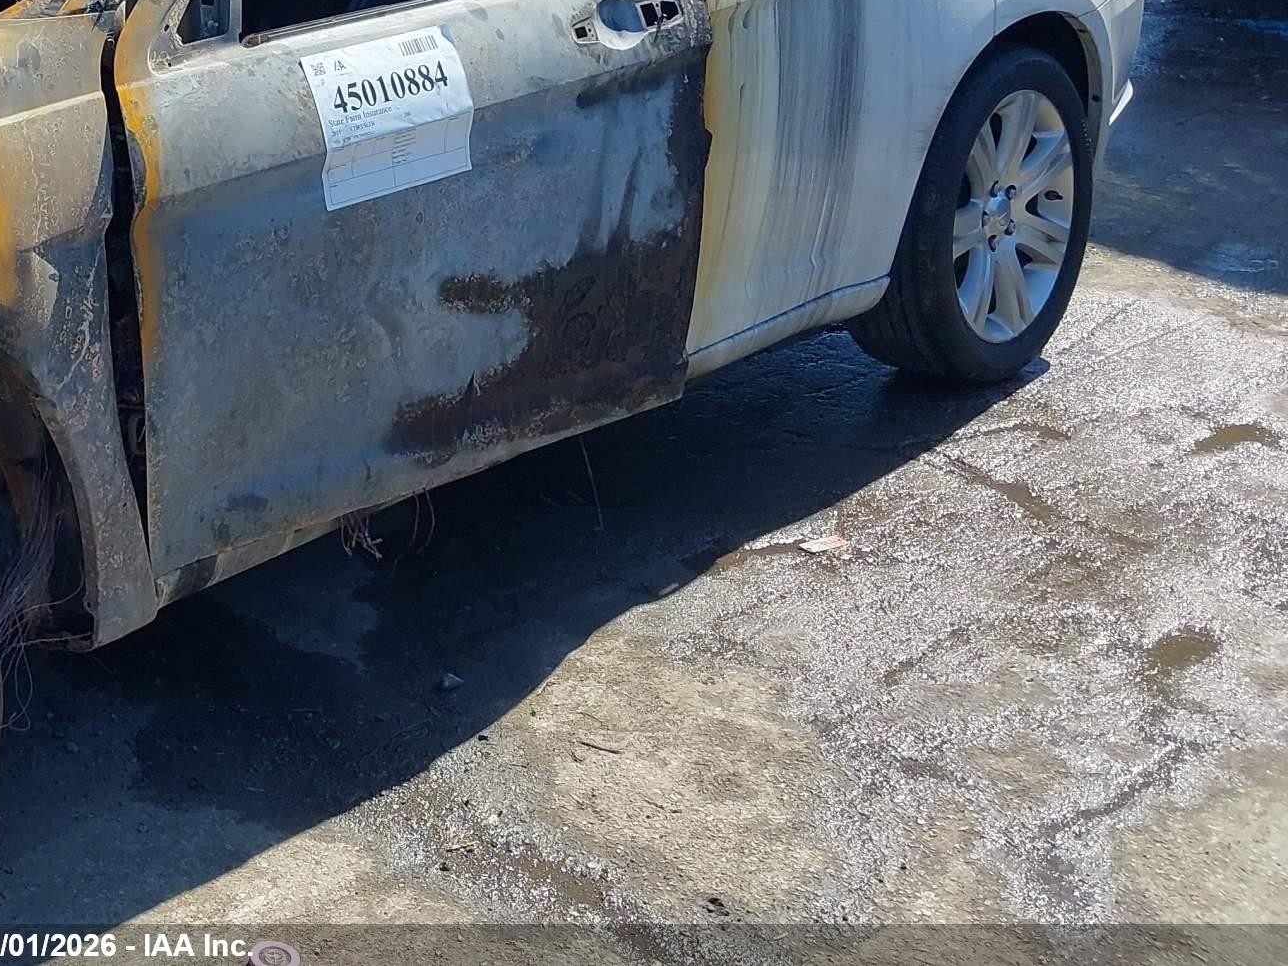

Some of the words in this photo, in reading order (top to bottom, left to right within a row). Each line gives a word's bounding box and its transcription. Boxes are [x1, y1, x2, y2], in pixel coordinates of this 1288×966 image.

[333, 60, 449, 114] 45010884
[328, 117, 345, 128] State
[345, 113, 362, 124] Farm
[362, 106, 393, 119] Insurance
